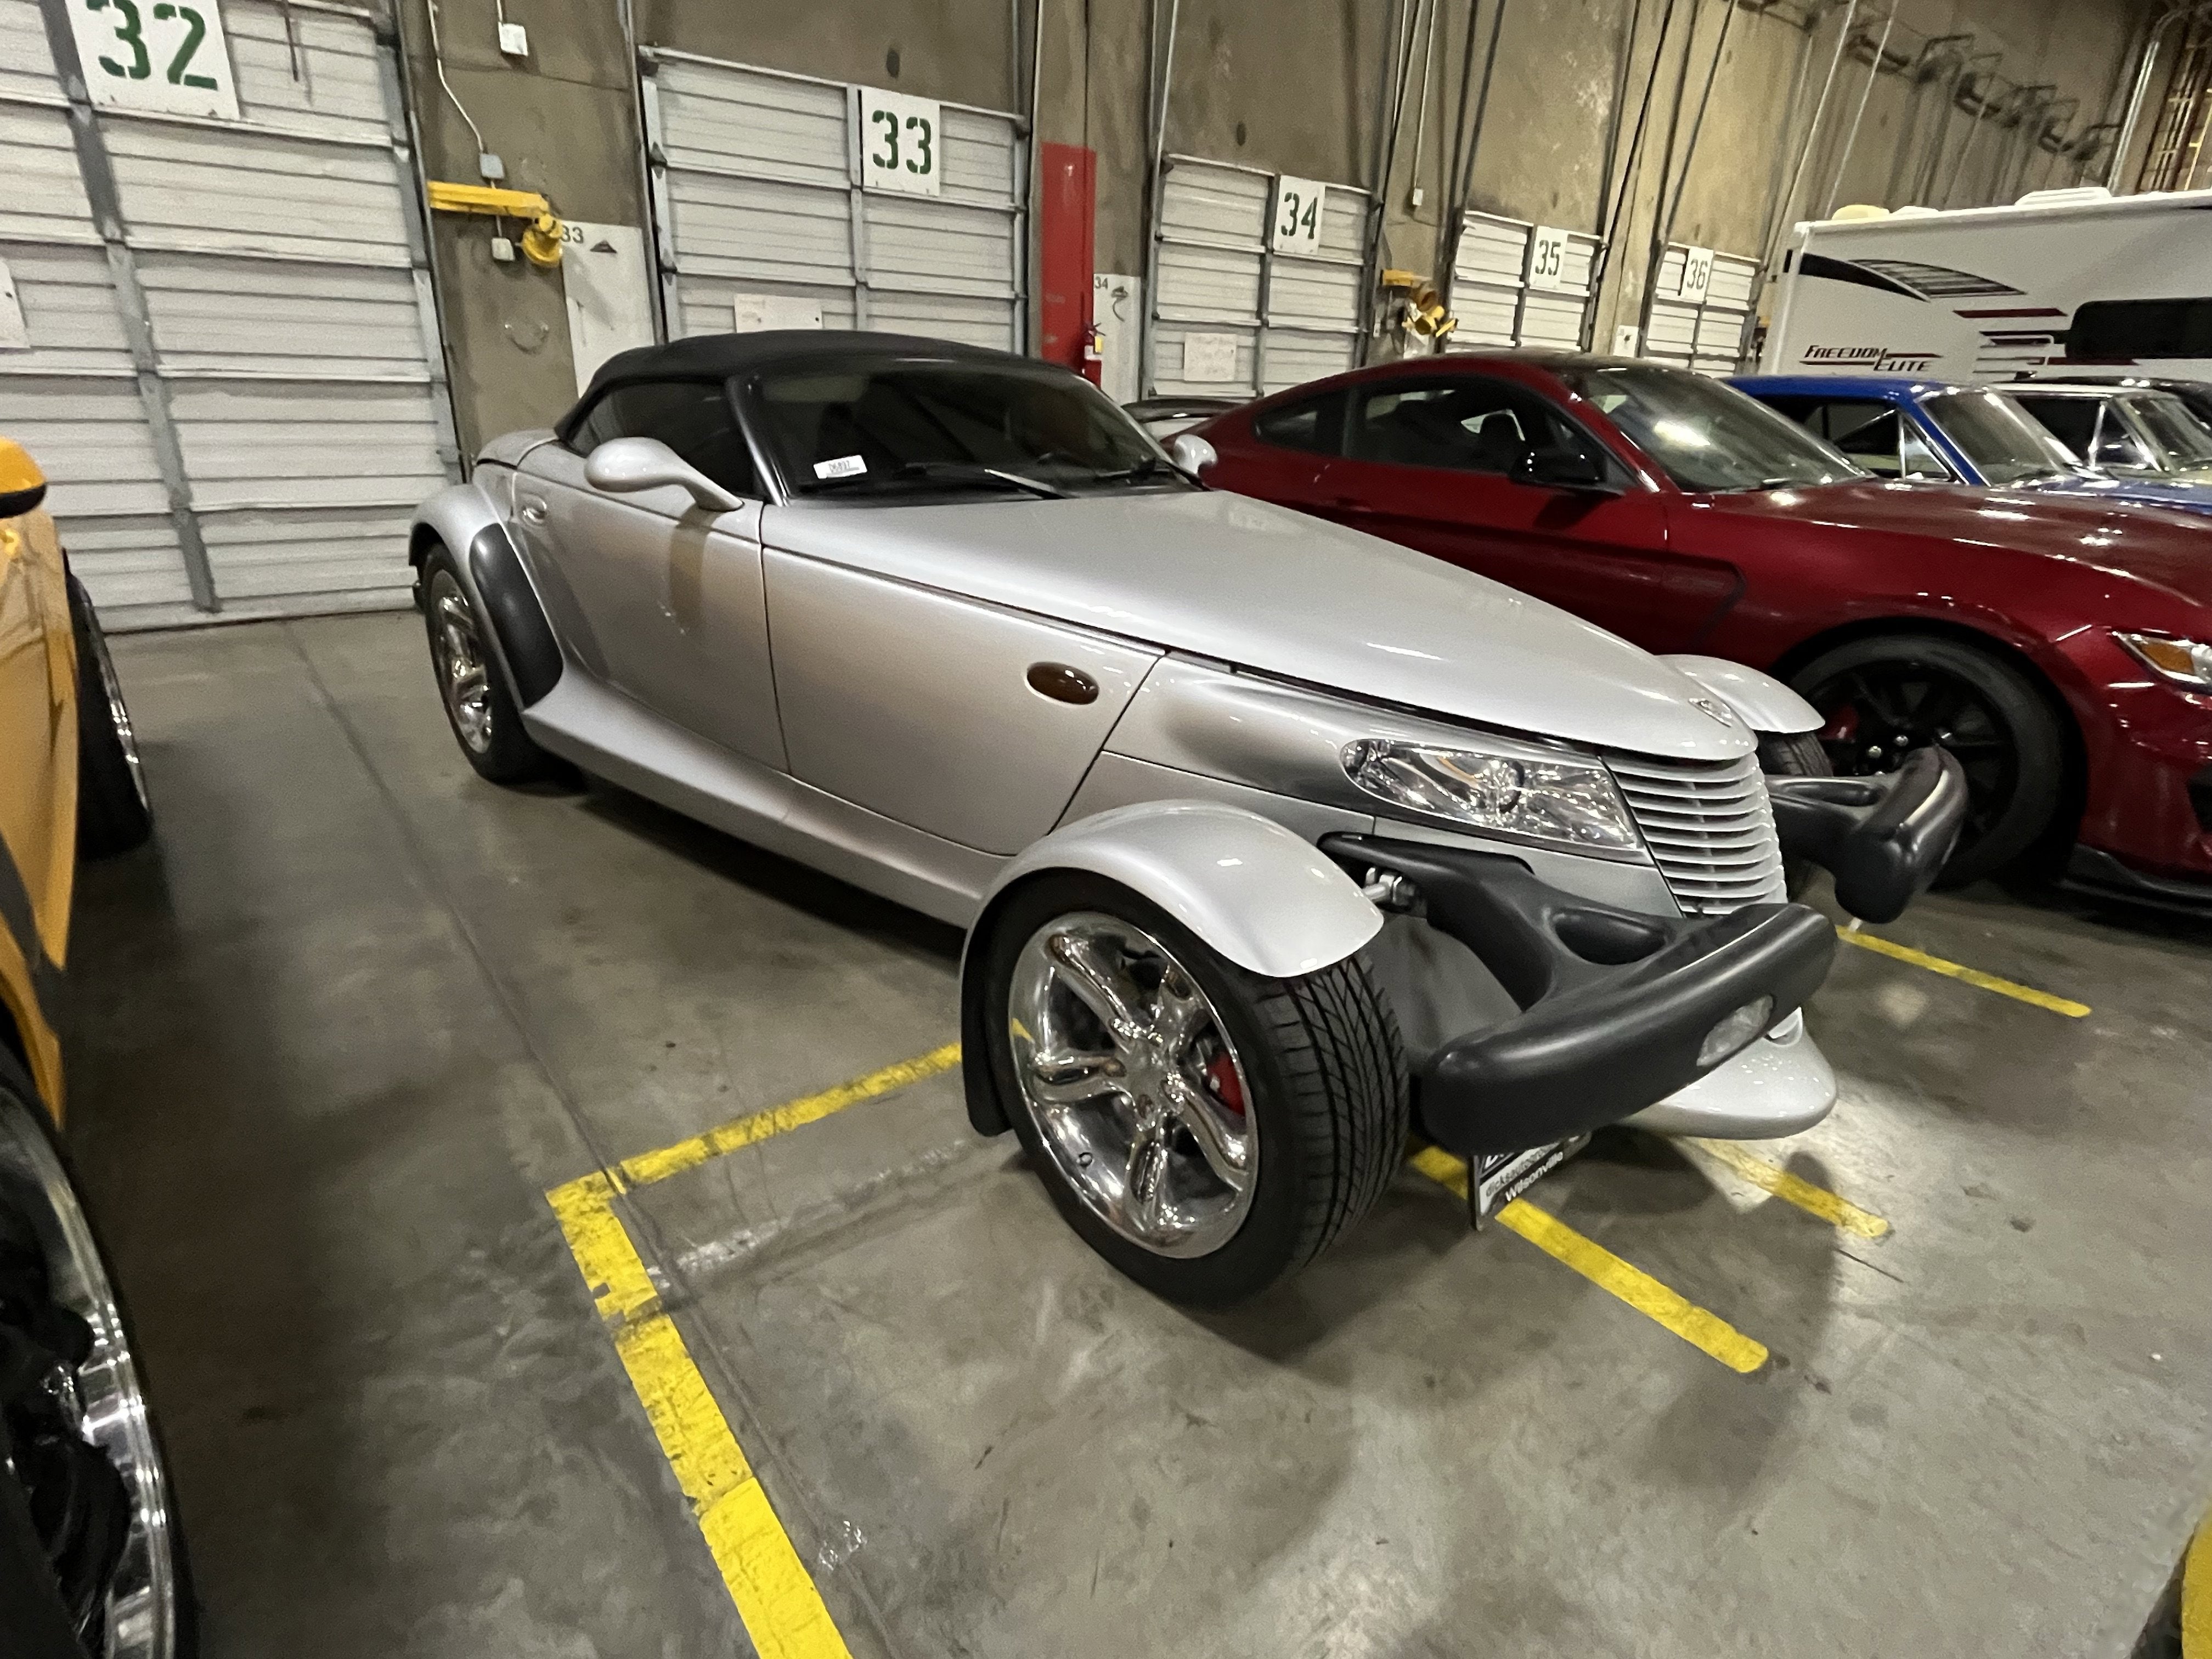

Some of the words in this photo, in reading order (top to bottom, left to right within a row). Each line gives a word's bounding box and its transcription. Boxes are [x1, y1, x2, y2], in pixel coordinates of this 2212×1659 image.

[86, 0, 218, 91] 32
[872, 110, 932, 174] 33
[1281, 192, 1318, 239] 34
[1535, 240, 1561, 276] 35
[1686, 258, 1708, 290] 36
[1095, 276, 1108, 290] 34
[1804, 345, 1888, 358] FREEDOM
[1874, 357, 1933, 372] ELITE
